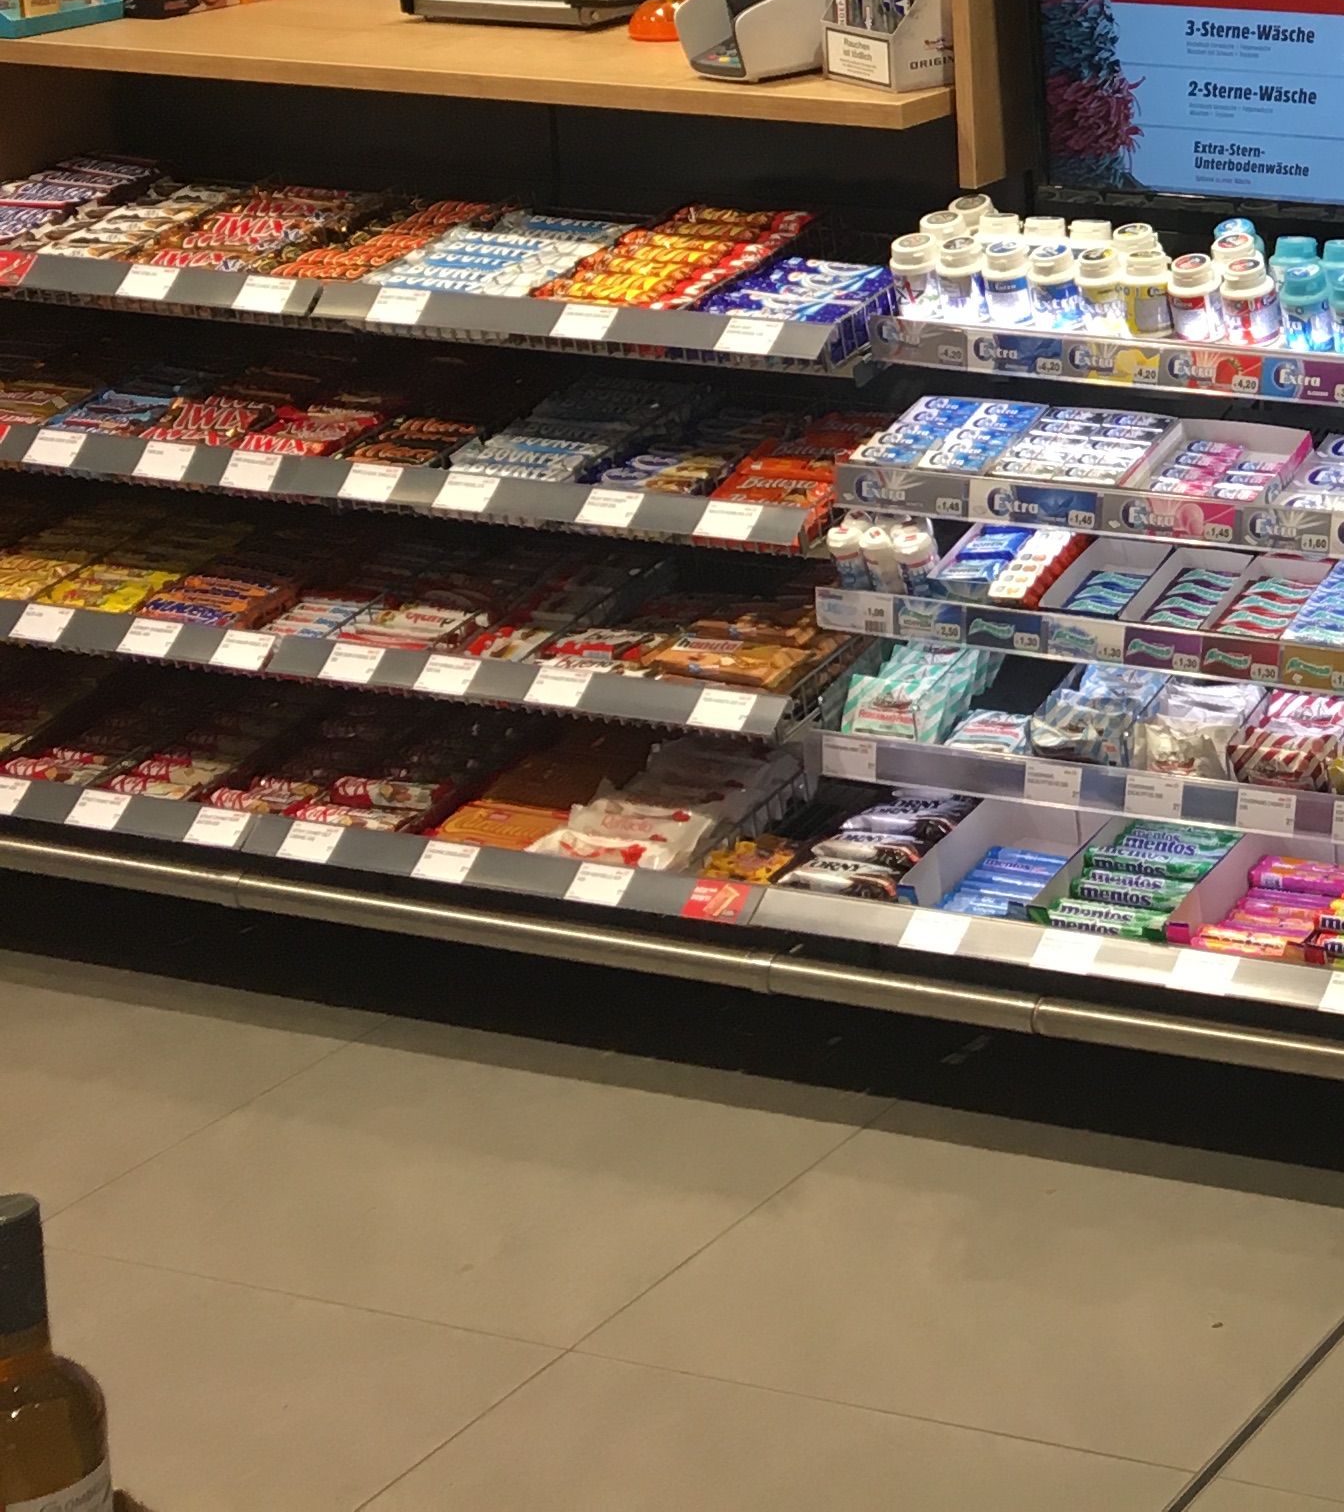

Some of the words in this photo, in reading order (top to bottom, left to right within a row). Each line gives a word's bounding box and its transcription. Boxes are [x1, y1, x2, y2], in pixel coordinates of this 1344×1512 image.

[1185, 18, 1316, 45] 3-Sterne-Wäsche
[1188, 79, 1318, 107] 2-Sterne-Wäsche
[1193, 140, 1266, 160] Extra-Stern-
[1193, 155, 1309, 179] Unterbodenwäsche
[974, 335, 1018, 361] Extra
[1169, 355, 1215, 381] Extra
[736, 476, 819, 490] Balisto
[988, 487, 1039, 515] Extra
[675, 638, 743, 652] hanuta
[1123, 835, 1196, 857] mentos
[1080, 886, 1152, 907] mentos
